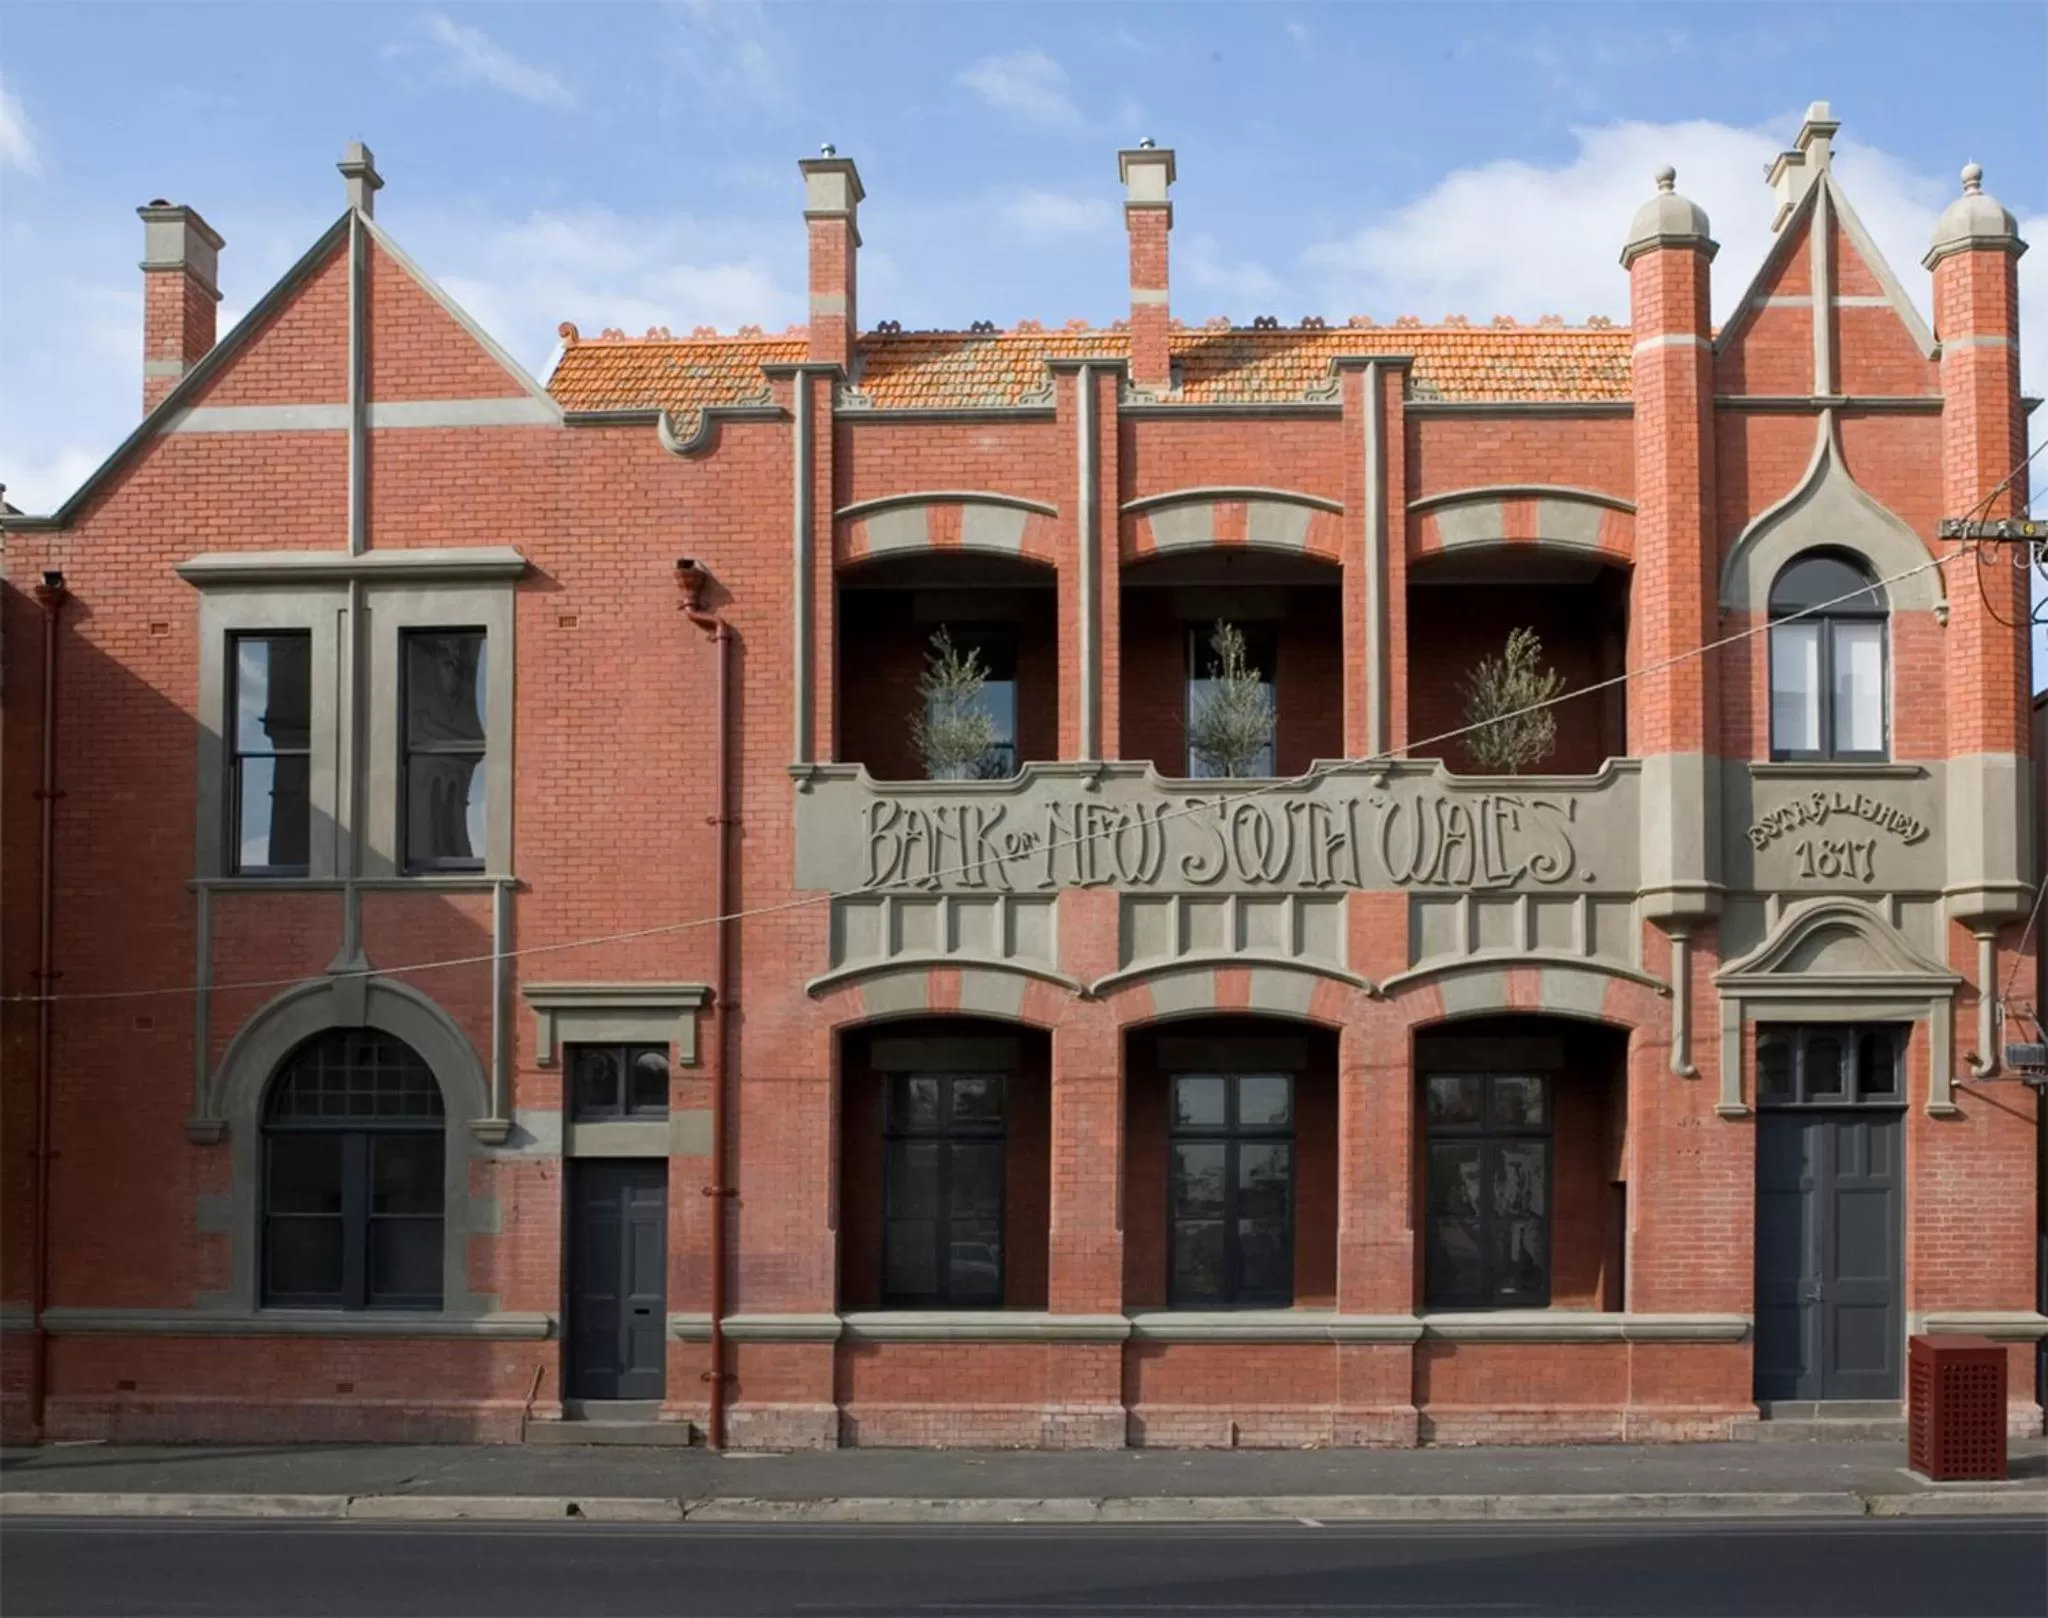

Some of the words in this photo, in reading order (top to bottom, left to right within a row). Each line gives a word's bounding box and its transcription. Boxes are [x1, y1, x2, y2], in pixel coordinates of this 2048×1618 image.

[863, 798, 1013, 892] BANK
[1037, 799, 1172, 889] NEW
[1180, 794, 1363, 889] SOUTH
[1794, 837, 1879, 885] 1817
